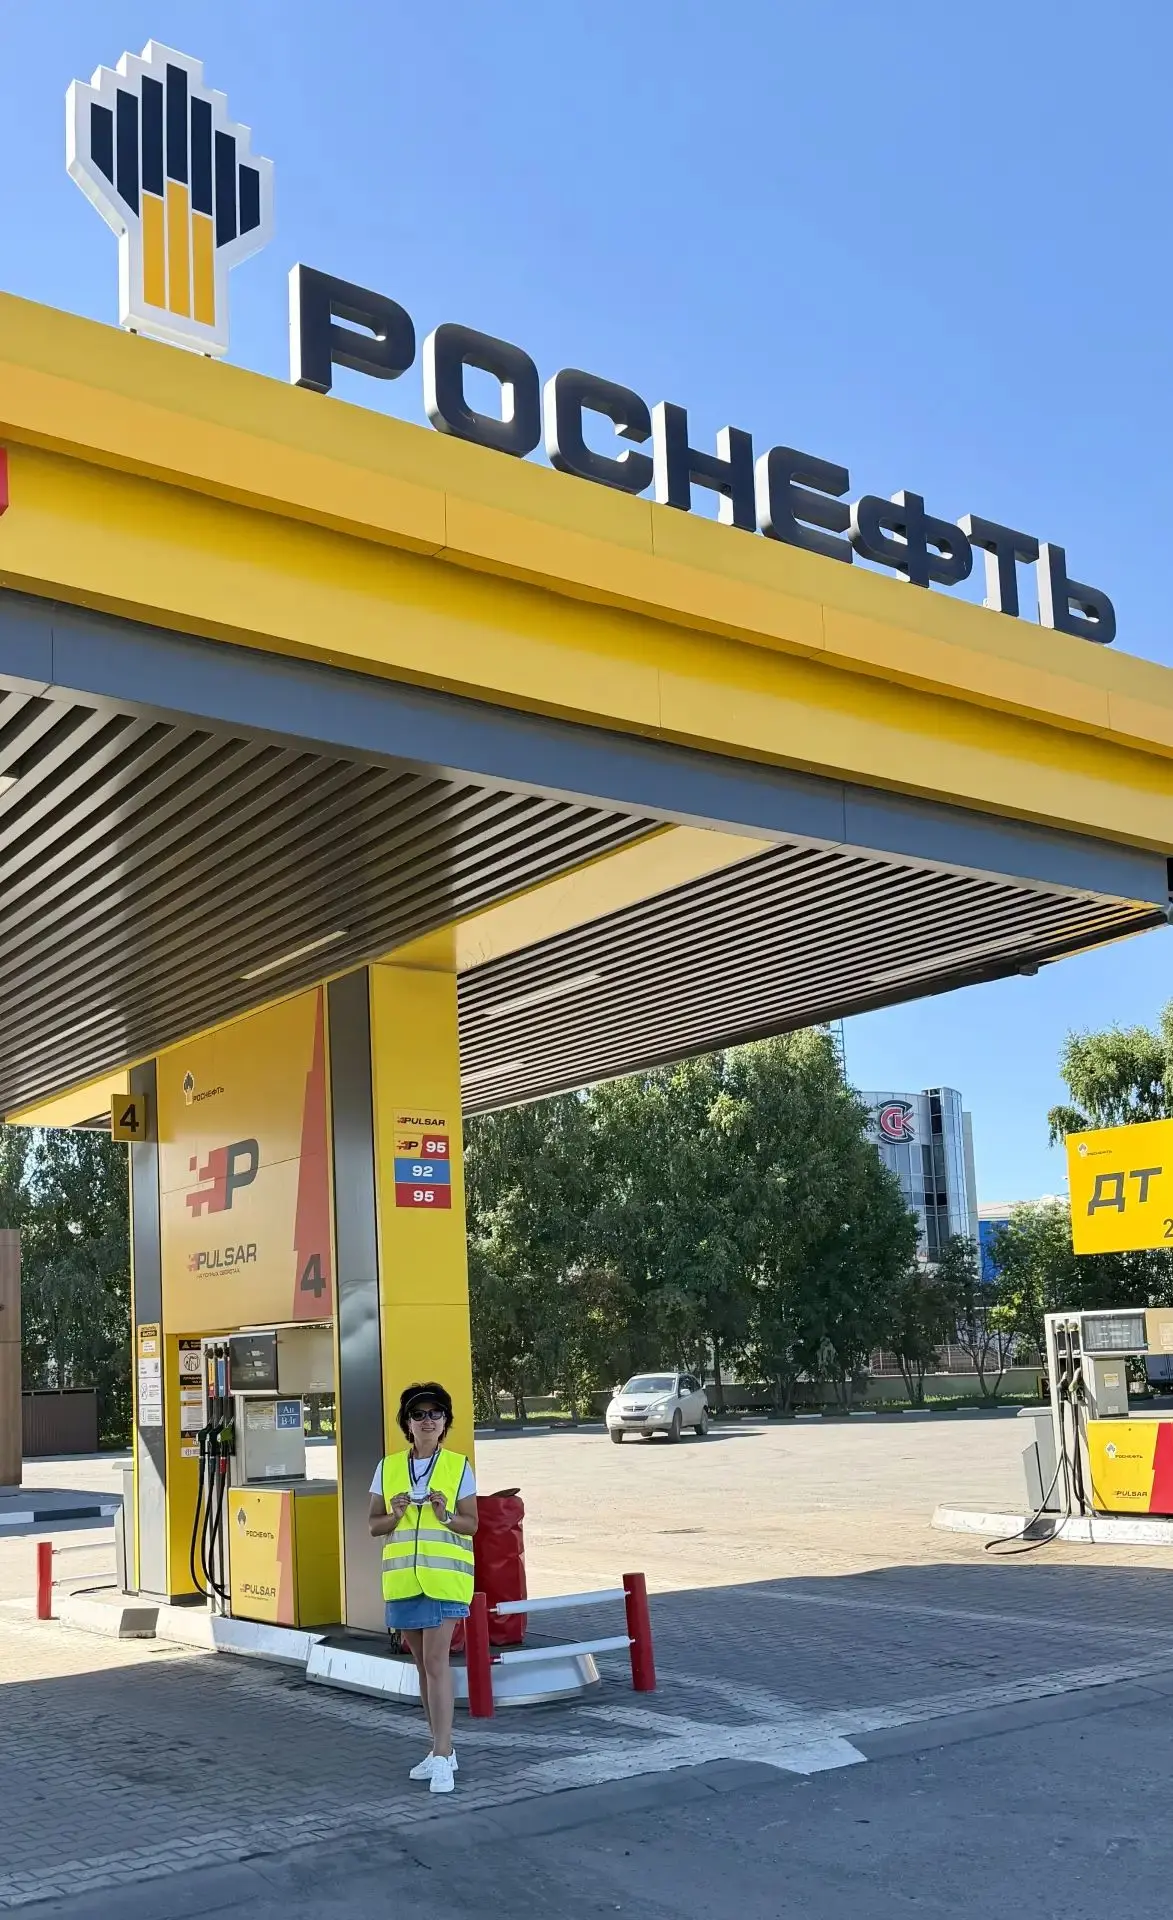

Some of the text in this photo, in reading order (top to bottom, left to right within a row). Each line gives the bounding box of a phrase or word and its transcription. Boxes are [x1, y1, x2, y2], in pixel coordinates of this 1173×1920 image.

[289, 263, 1117, 644] РОСНЕФТЬ
[193, 1087, 225, 1103] РОСНЕФТЬ
[119, 1103, 140, 1133] 4
[404, 1117, 446, 1127] PULSAR
[426, 1141, 447, 1153] 95
[412, 1165, 433, 1178] 92
[413, 1190, 435, 1202] 95
[1087, 1166, 1163, 1217] ДТ
[197, 1243, 258, 1271] PULSAR
[300, 1253, 327, 1299] 4
[246, 1530, 274, 1540] РОСНЕФТЬ
[244, 1583, 276, 1598] PULSAR
